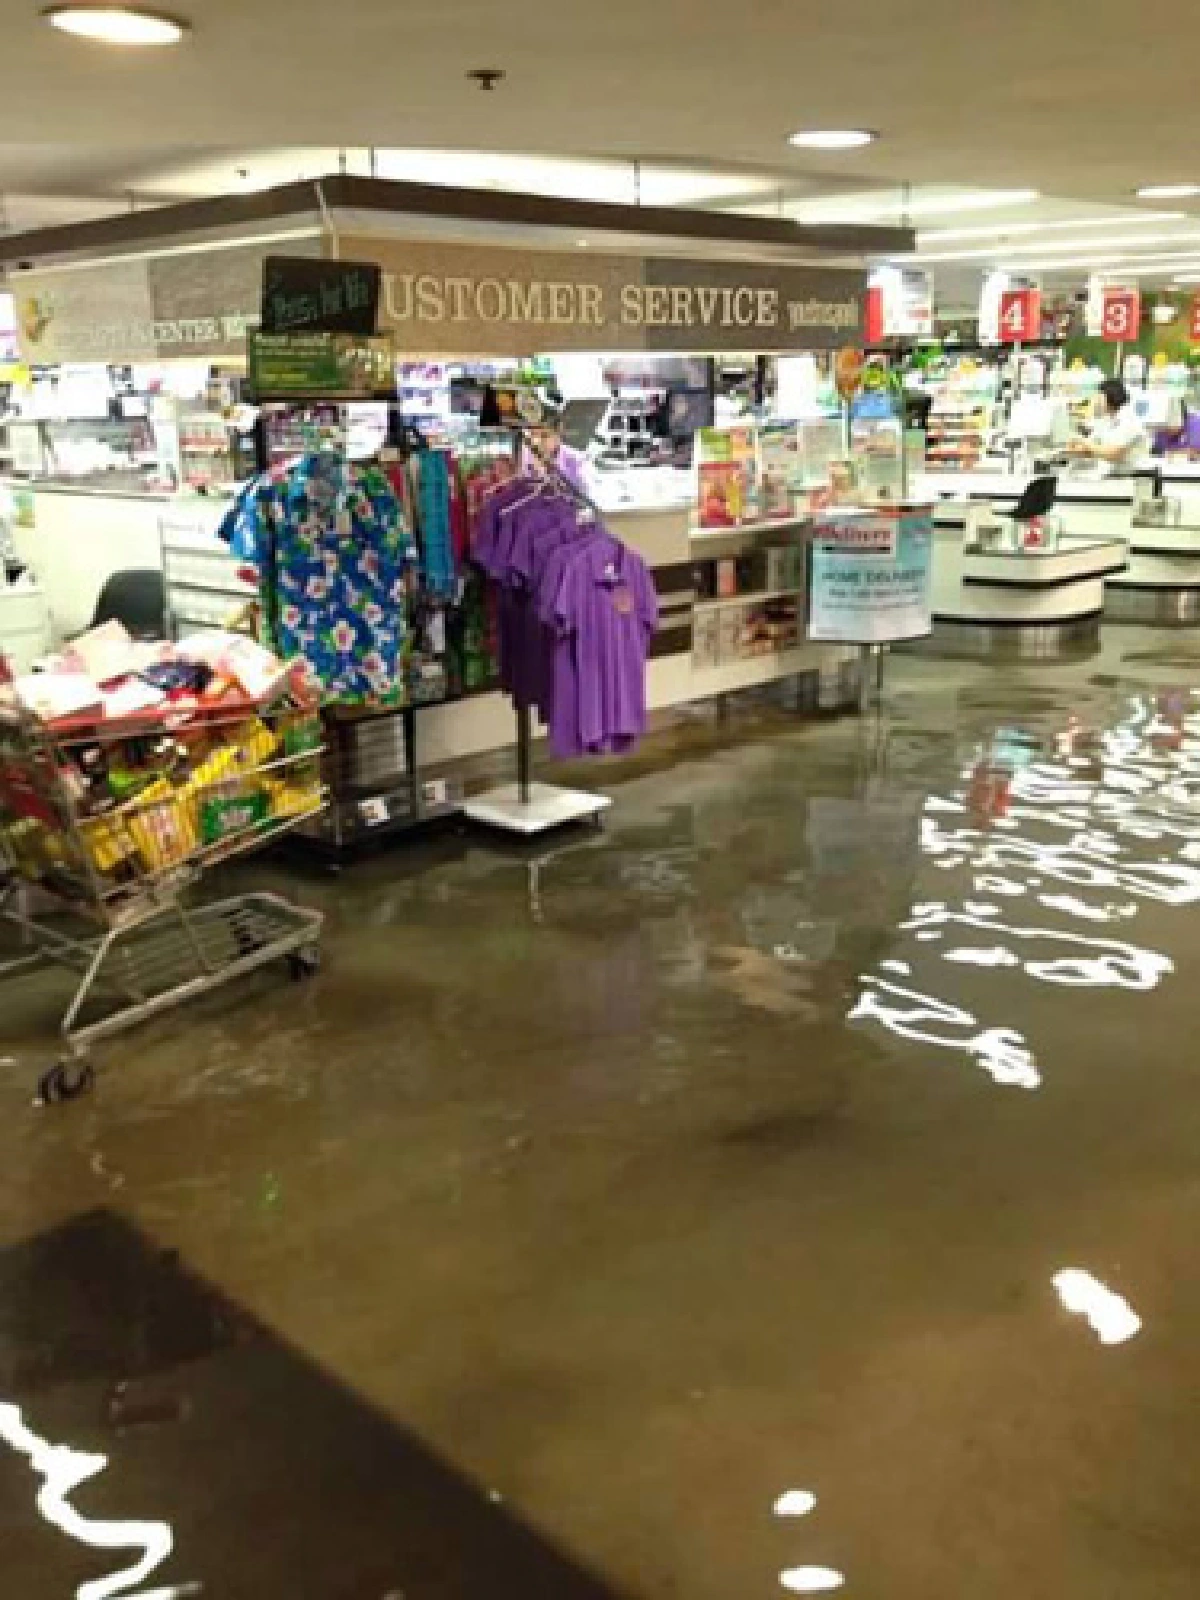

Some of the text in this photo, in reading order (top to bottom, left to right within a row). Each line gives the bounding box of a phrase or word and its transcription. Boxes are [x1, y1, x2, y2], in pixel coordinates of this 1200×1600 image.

[381, 274, 605, 324] USTOMER
[620, 284, 779, 328] SERVICE
[1002, 299, 1025, 331] 4
[1104, 301, 1128, 333] 3
